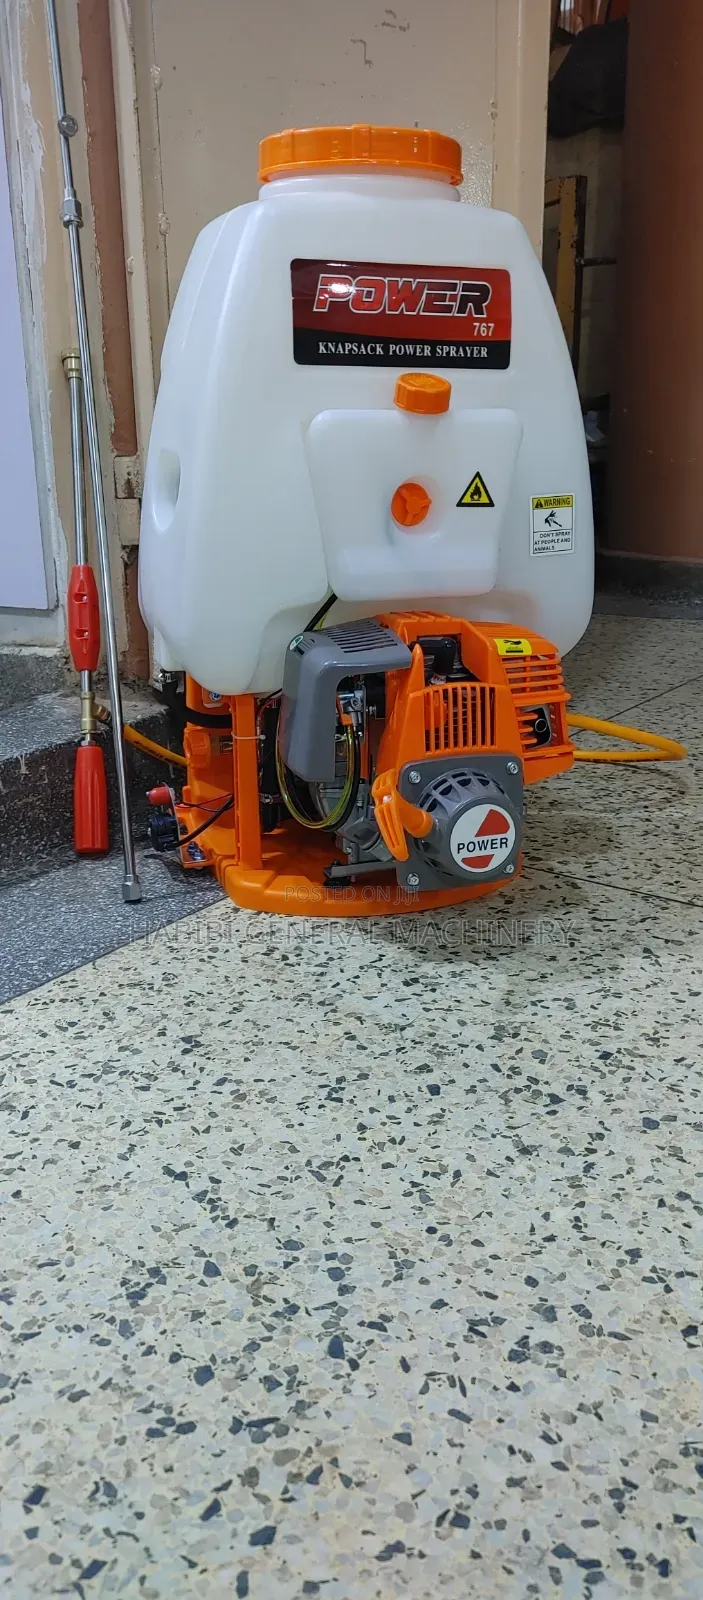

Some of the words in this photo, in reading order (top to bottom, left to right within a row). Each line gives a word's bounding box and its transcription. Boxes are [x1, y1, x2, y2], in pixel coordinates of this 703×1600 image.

[313, 274, 492, 317] POWER
[473, 323, 495, 337] 767
[318, 342, 384, 355] KNAPSACK
[389, 343, 431, 357] POWER
[436, 345, 488, 358] SPRAYER
[543, 497, 570, 507] WARNING
[457, 837, 508, 854] POWER
